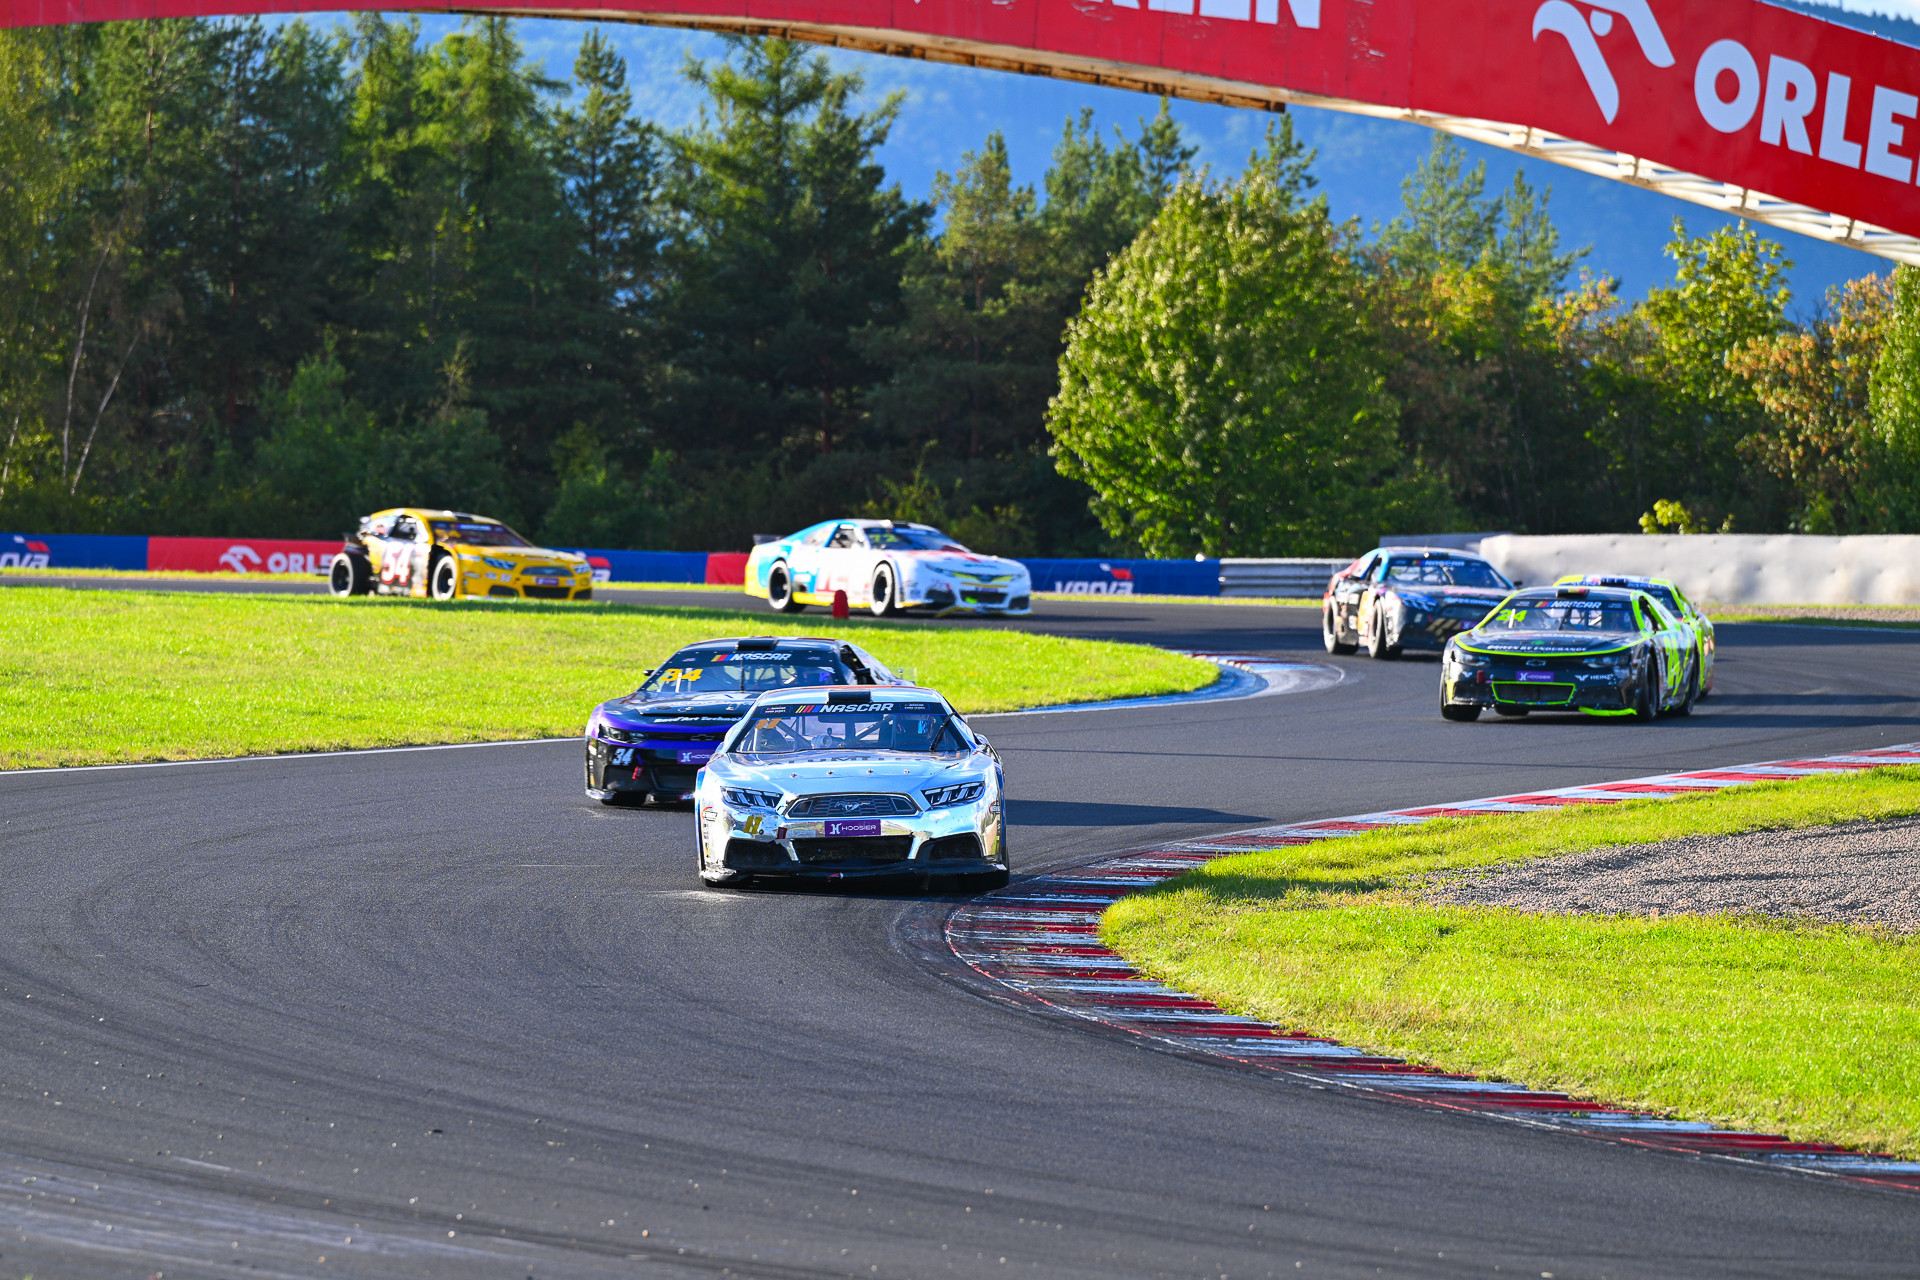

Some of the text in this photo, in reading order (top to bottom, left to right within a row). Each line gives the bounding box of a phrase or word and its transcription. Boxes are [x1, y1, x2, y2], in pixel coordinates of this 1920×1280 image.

[1694, 38, 1920, 187] ORLE
[268, 552, 335, 574] ORLE
[381, 541, 412, 586] 54
[1495, 609, 1527, 622] 24
[730, 653, 792, 661] NASCAR
[660, 668, 704, 682] 34
[819, 703, 894, 713] NASCAR
[611, 748, 636, 766] 34
